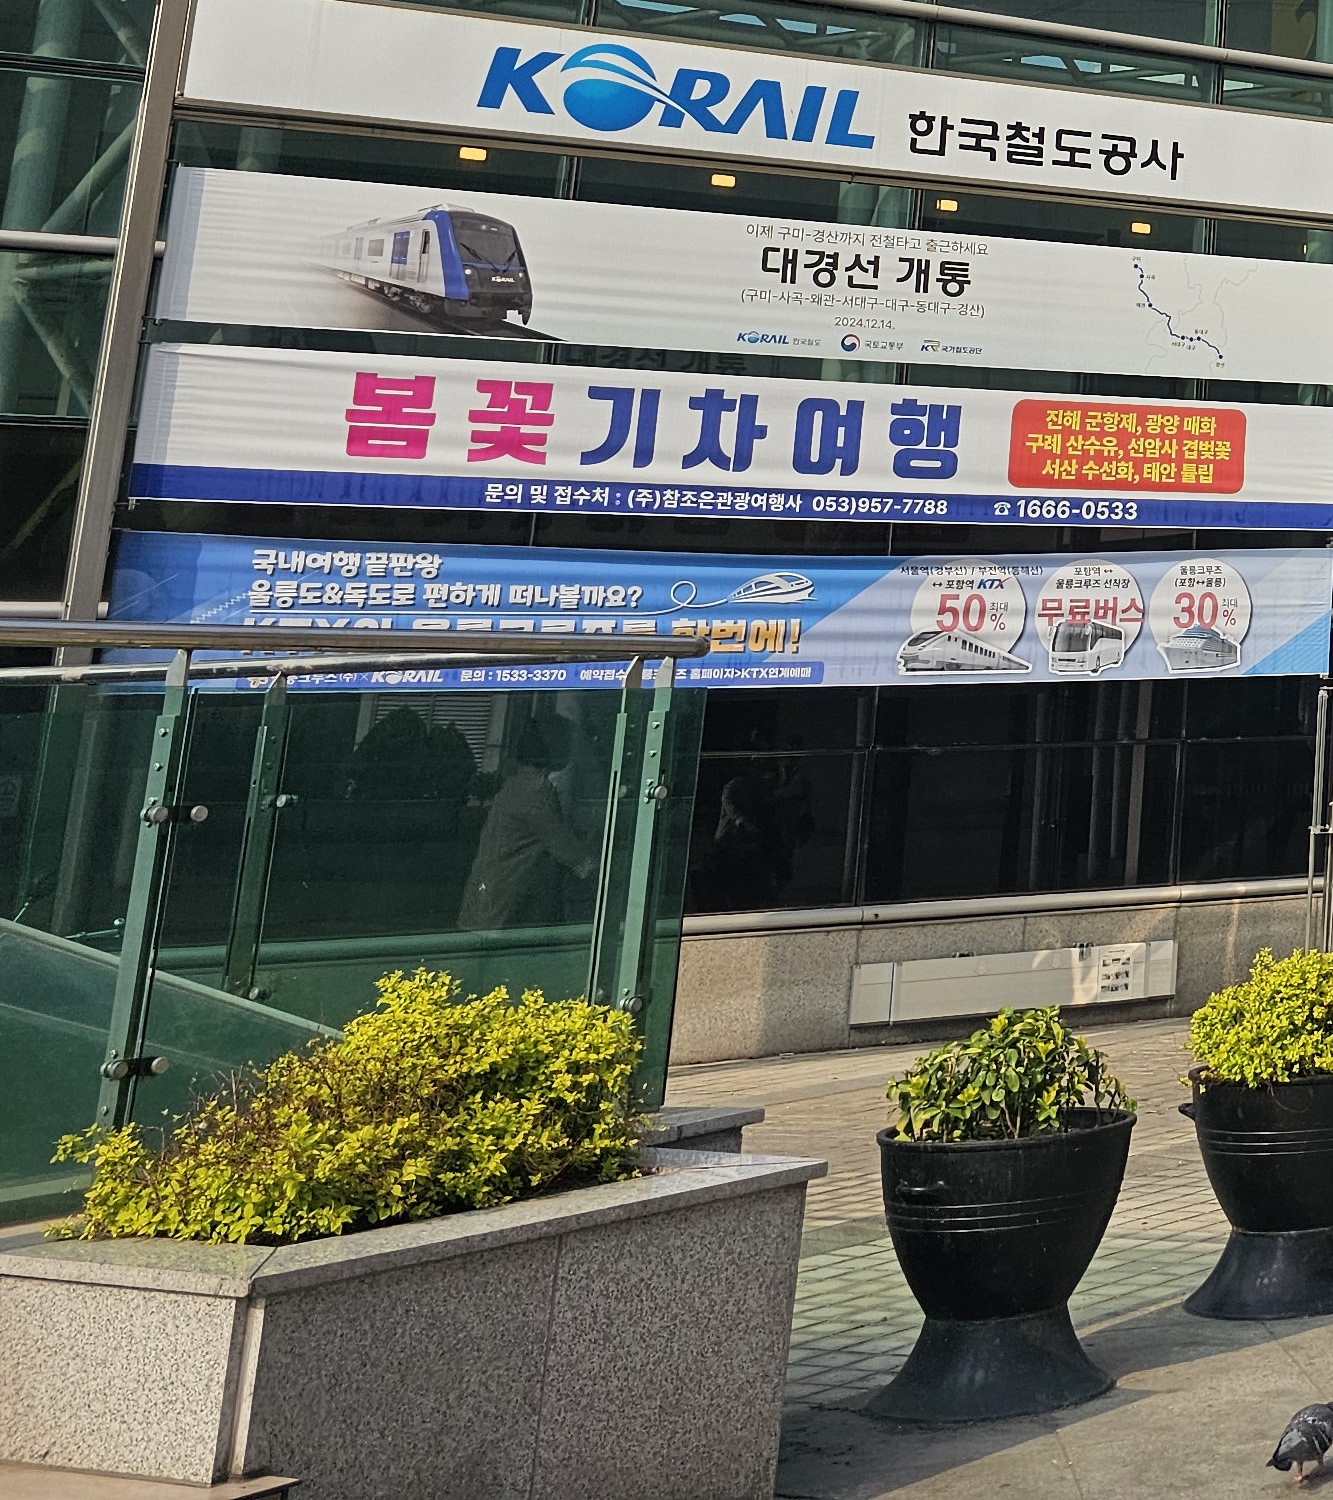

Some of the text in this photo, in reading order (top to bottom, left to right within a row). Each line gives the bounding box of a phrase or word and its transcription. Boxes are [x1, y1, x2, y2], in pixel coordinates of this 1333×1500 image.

[477, 44, 876, 149] KORAIL
[907, 110, 1185, 181] 한국철도공사
[746, 223, 989, 256] 이제 구미-경산까지 전철타고 출근하세요
[761, 246, 972, 298] 대경선 개통
[833, 316, 896, 331] 2024.12.14.
[736, 330, 790, 346] KORAIL
[1045, 409, 1217, 437] 진해 군항제, 광양 매화
[1025, 434, 1232, 461] 구례 산수유, 선암사 겹벚꽃
[1042, 459, 1214, 484] 서산 수선화, 태안 튤립
[484, 483, 523, 503] 문의
[529, 485, 548, 505] 및
[553, 485, 610, 507] 접수처
[626, 488, 803, 514] (주)참조은관광여행사
[812, 495, 948, 516] 053)957-7788
[1016, 499, 1138, 520] 1666-0533
[252, 549, 443, 579] 국내여행 끝판왕
[1073, 566, 1101, 576] 포항역
[249, 579, 643, 610] 울릉도&독도로 편하게 떠나볼까요?
[944, 577, 1009, 590] 포항역 KTX
[1055, 578, 1101, 590] 울릉크루즈
[935, 593, 987, 632] 50
[989, 601, 1009, 613] 최대
[1037, 597, 1146, 627] 무료버스
[1173, 591, 1219, 629] 30
[1221, 598, 1238, 609] 최대
[990, 613, 1006, 631] %
[1222, 609, 1237, 626] %
[371, 670, 443, 685] KORAIL
[460, 669, 486, 682] 문의
[496, 669, 567, 682] 1533-3370
